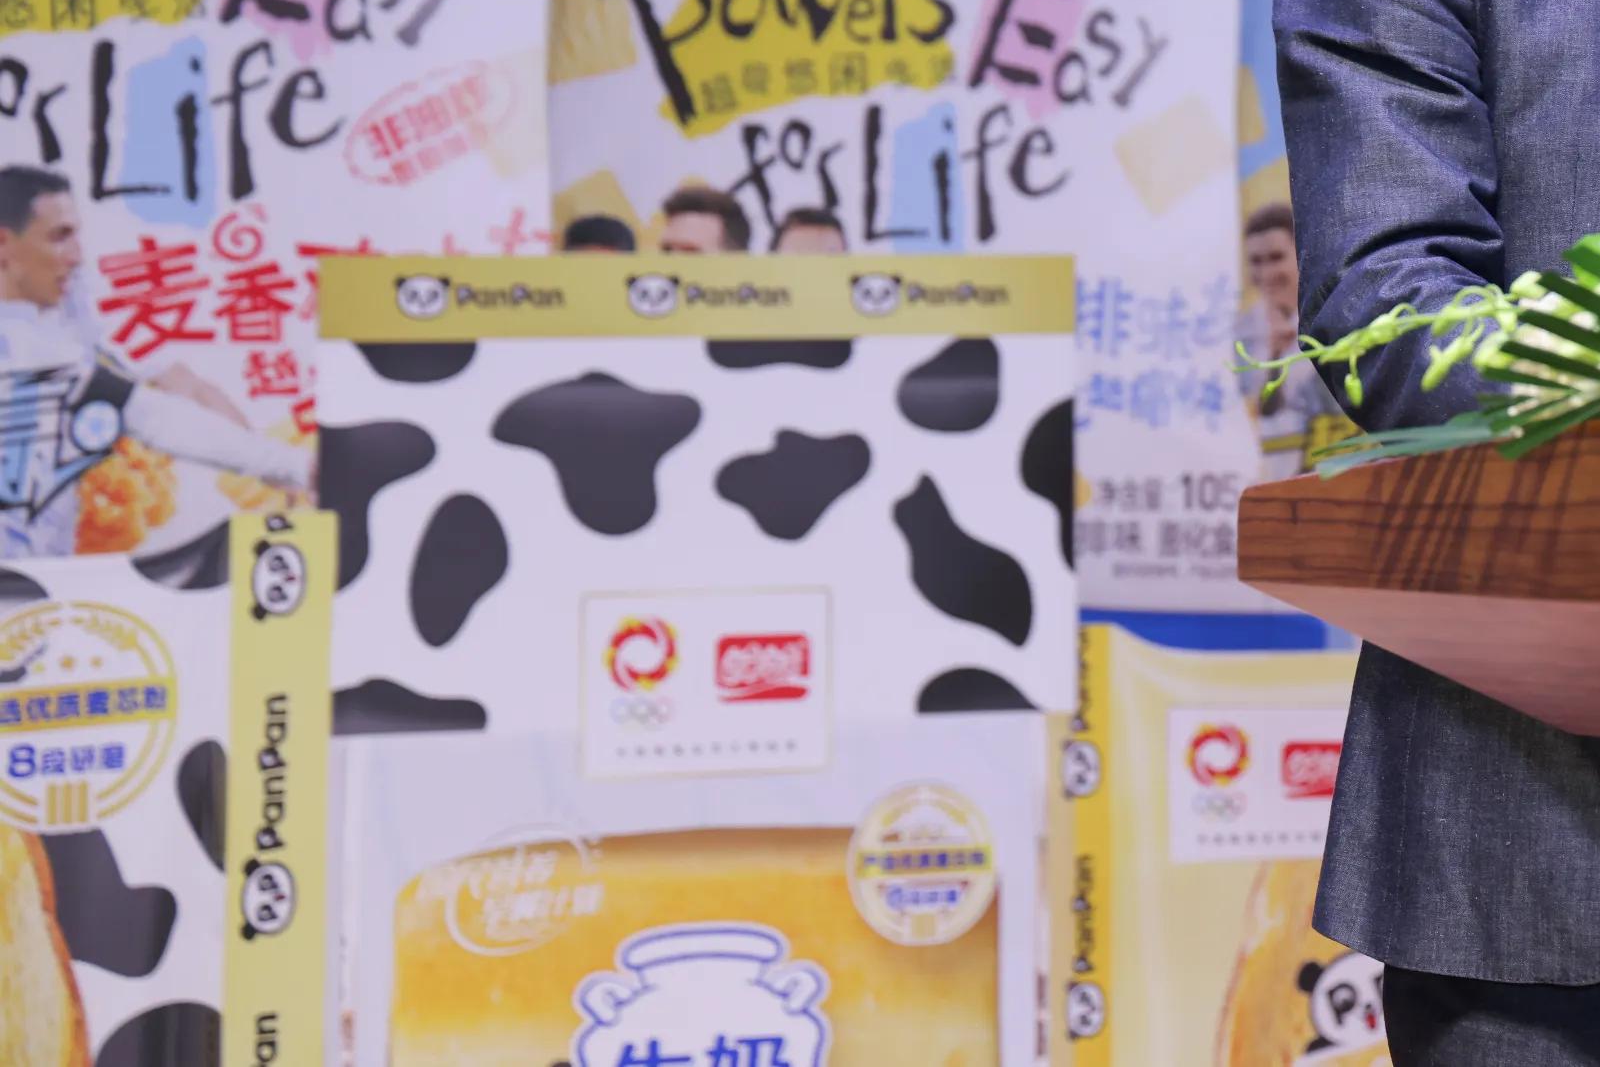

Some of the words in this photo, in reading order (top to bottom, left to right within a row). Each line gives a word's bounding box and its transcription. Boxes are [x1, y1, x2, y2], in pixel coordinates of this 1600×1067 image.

[90, 39, 348, 200] Life
[864, 105, 1070, 242] Life
[457, 285, 565, 307] PanPan
[686, 286, 790, 306] PanPan
[907, 283, 1009, 305] PanPan
[257, 694, 287, 851] PanPan
